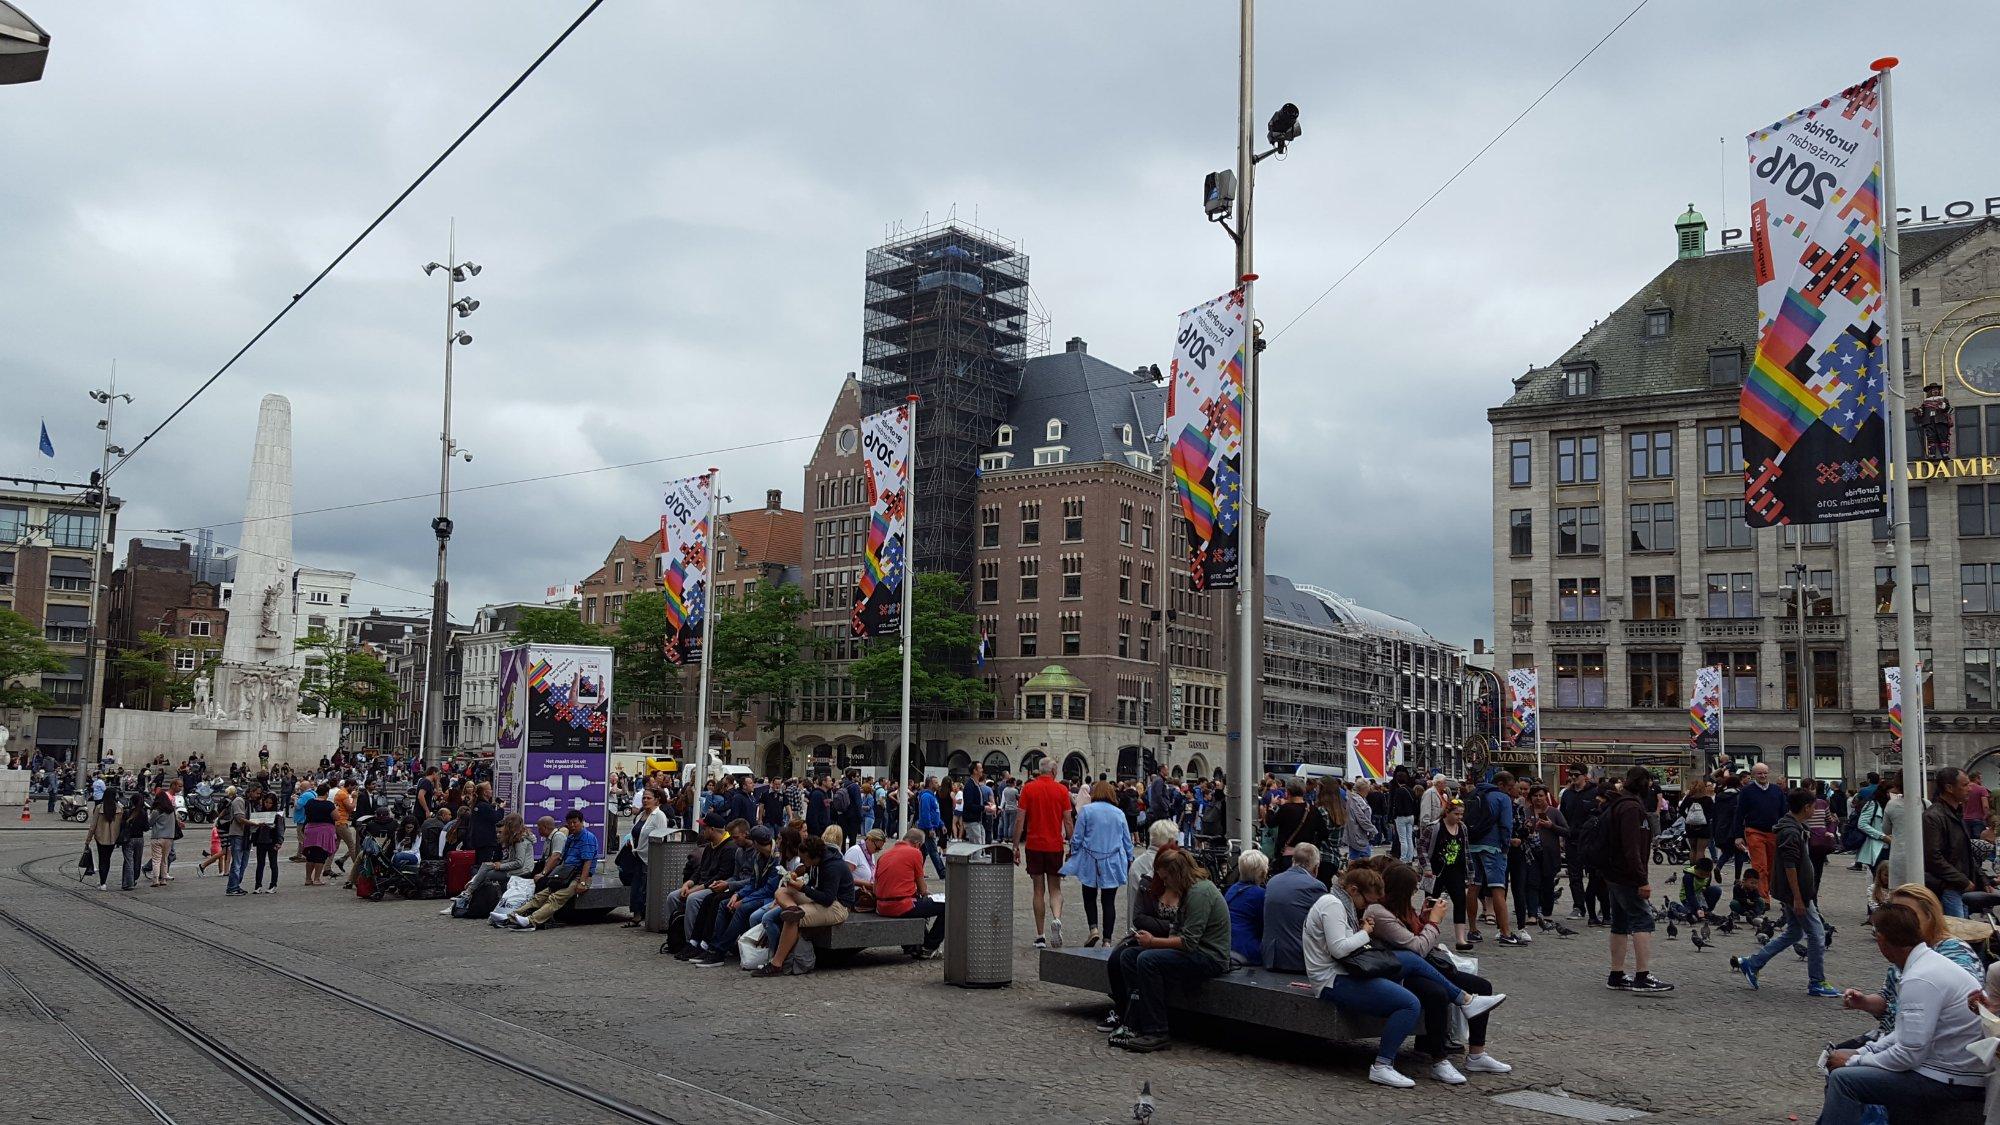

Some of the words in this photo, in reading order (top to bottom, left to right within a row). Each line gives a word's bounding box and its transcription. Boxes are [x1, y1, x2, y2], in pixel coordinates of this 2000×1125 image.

[1889, 457, 1998, 480] DAME
[978, 736, 1013, 746] GASSAN
[1188, 740, 1209, 750] GASSAN
[1497, 752, 1547, 763] MADAME
